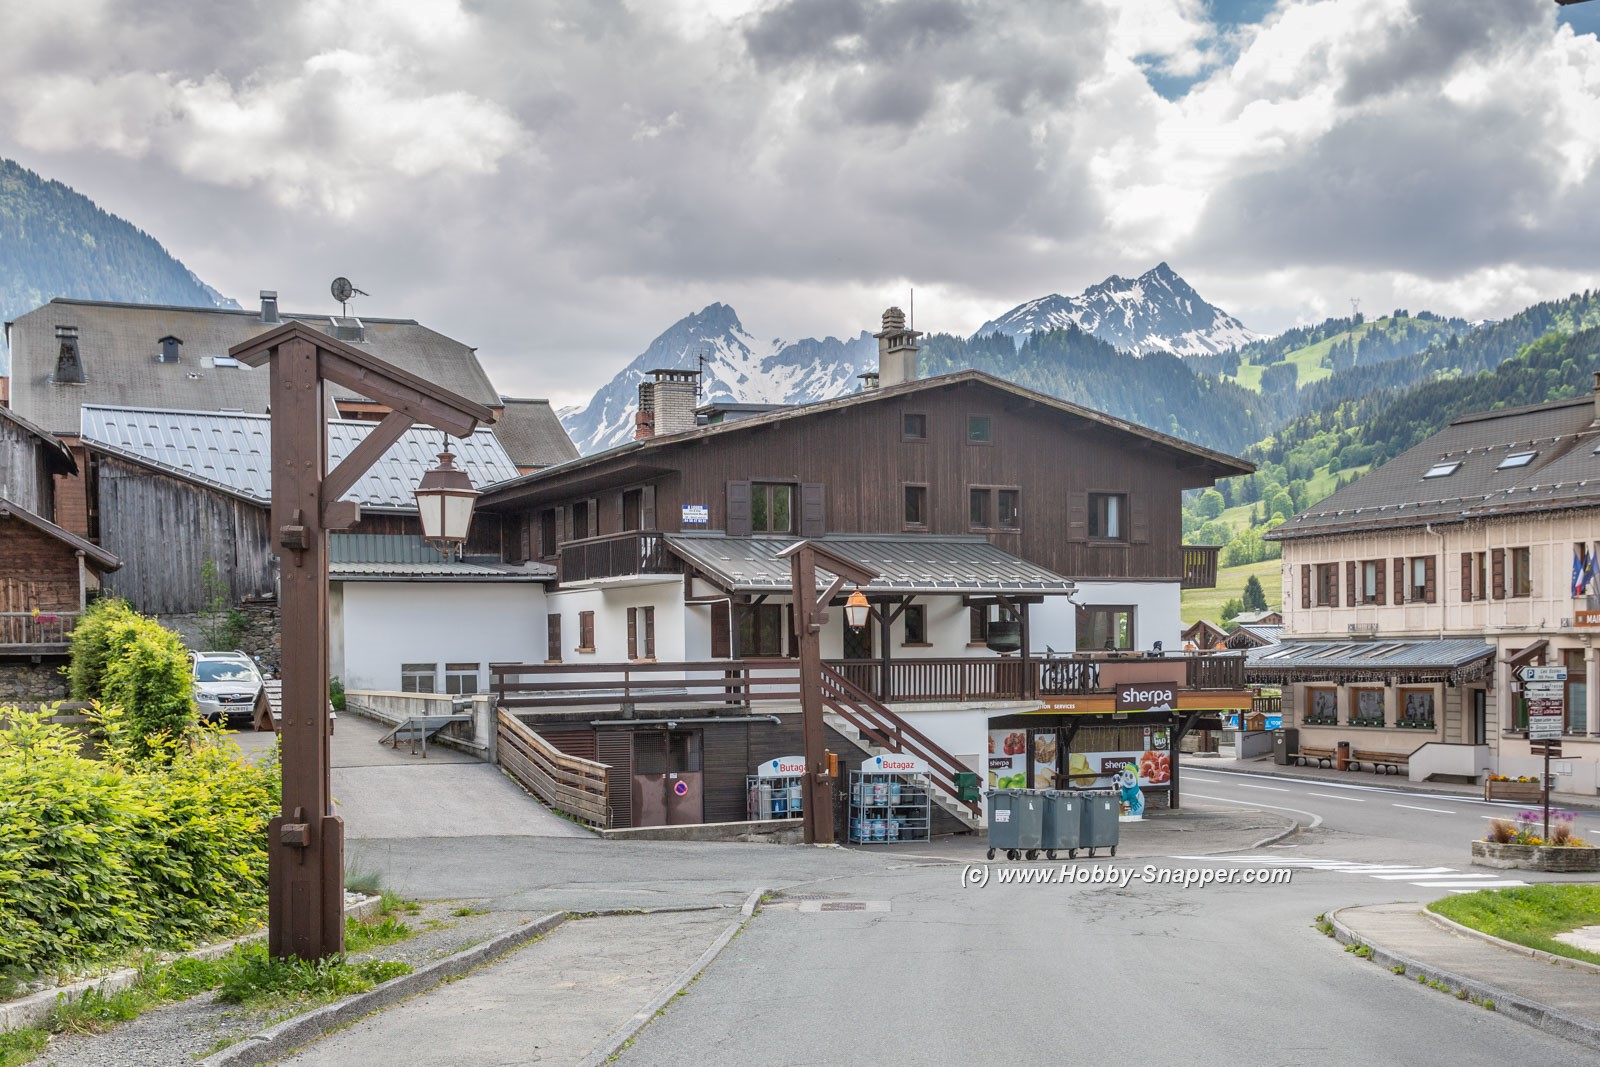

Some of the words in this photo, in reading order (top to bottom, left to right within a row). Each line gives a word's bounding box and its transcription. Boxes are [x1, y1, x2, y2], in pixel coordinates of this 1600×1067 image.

[1122, 687, 1172, 704] sherpa
[1153, 735, 1166, 747] bio
[882, 760, 915, 771] Butagaz
[989, 760, 1010, 768] sherpa
[1104, 760, 1128, 770] sherp
